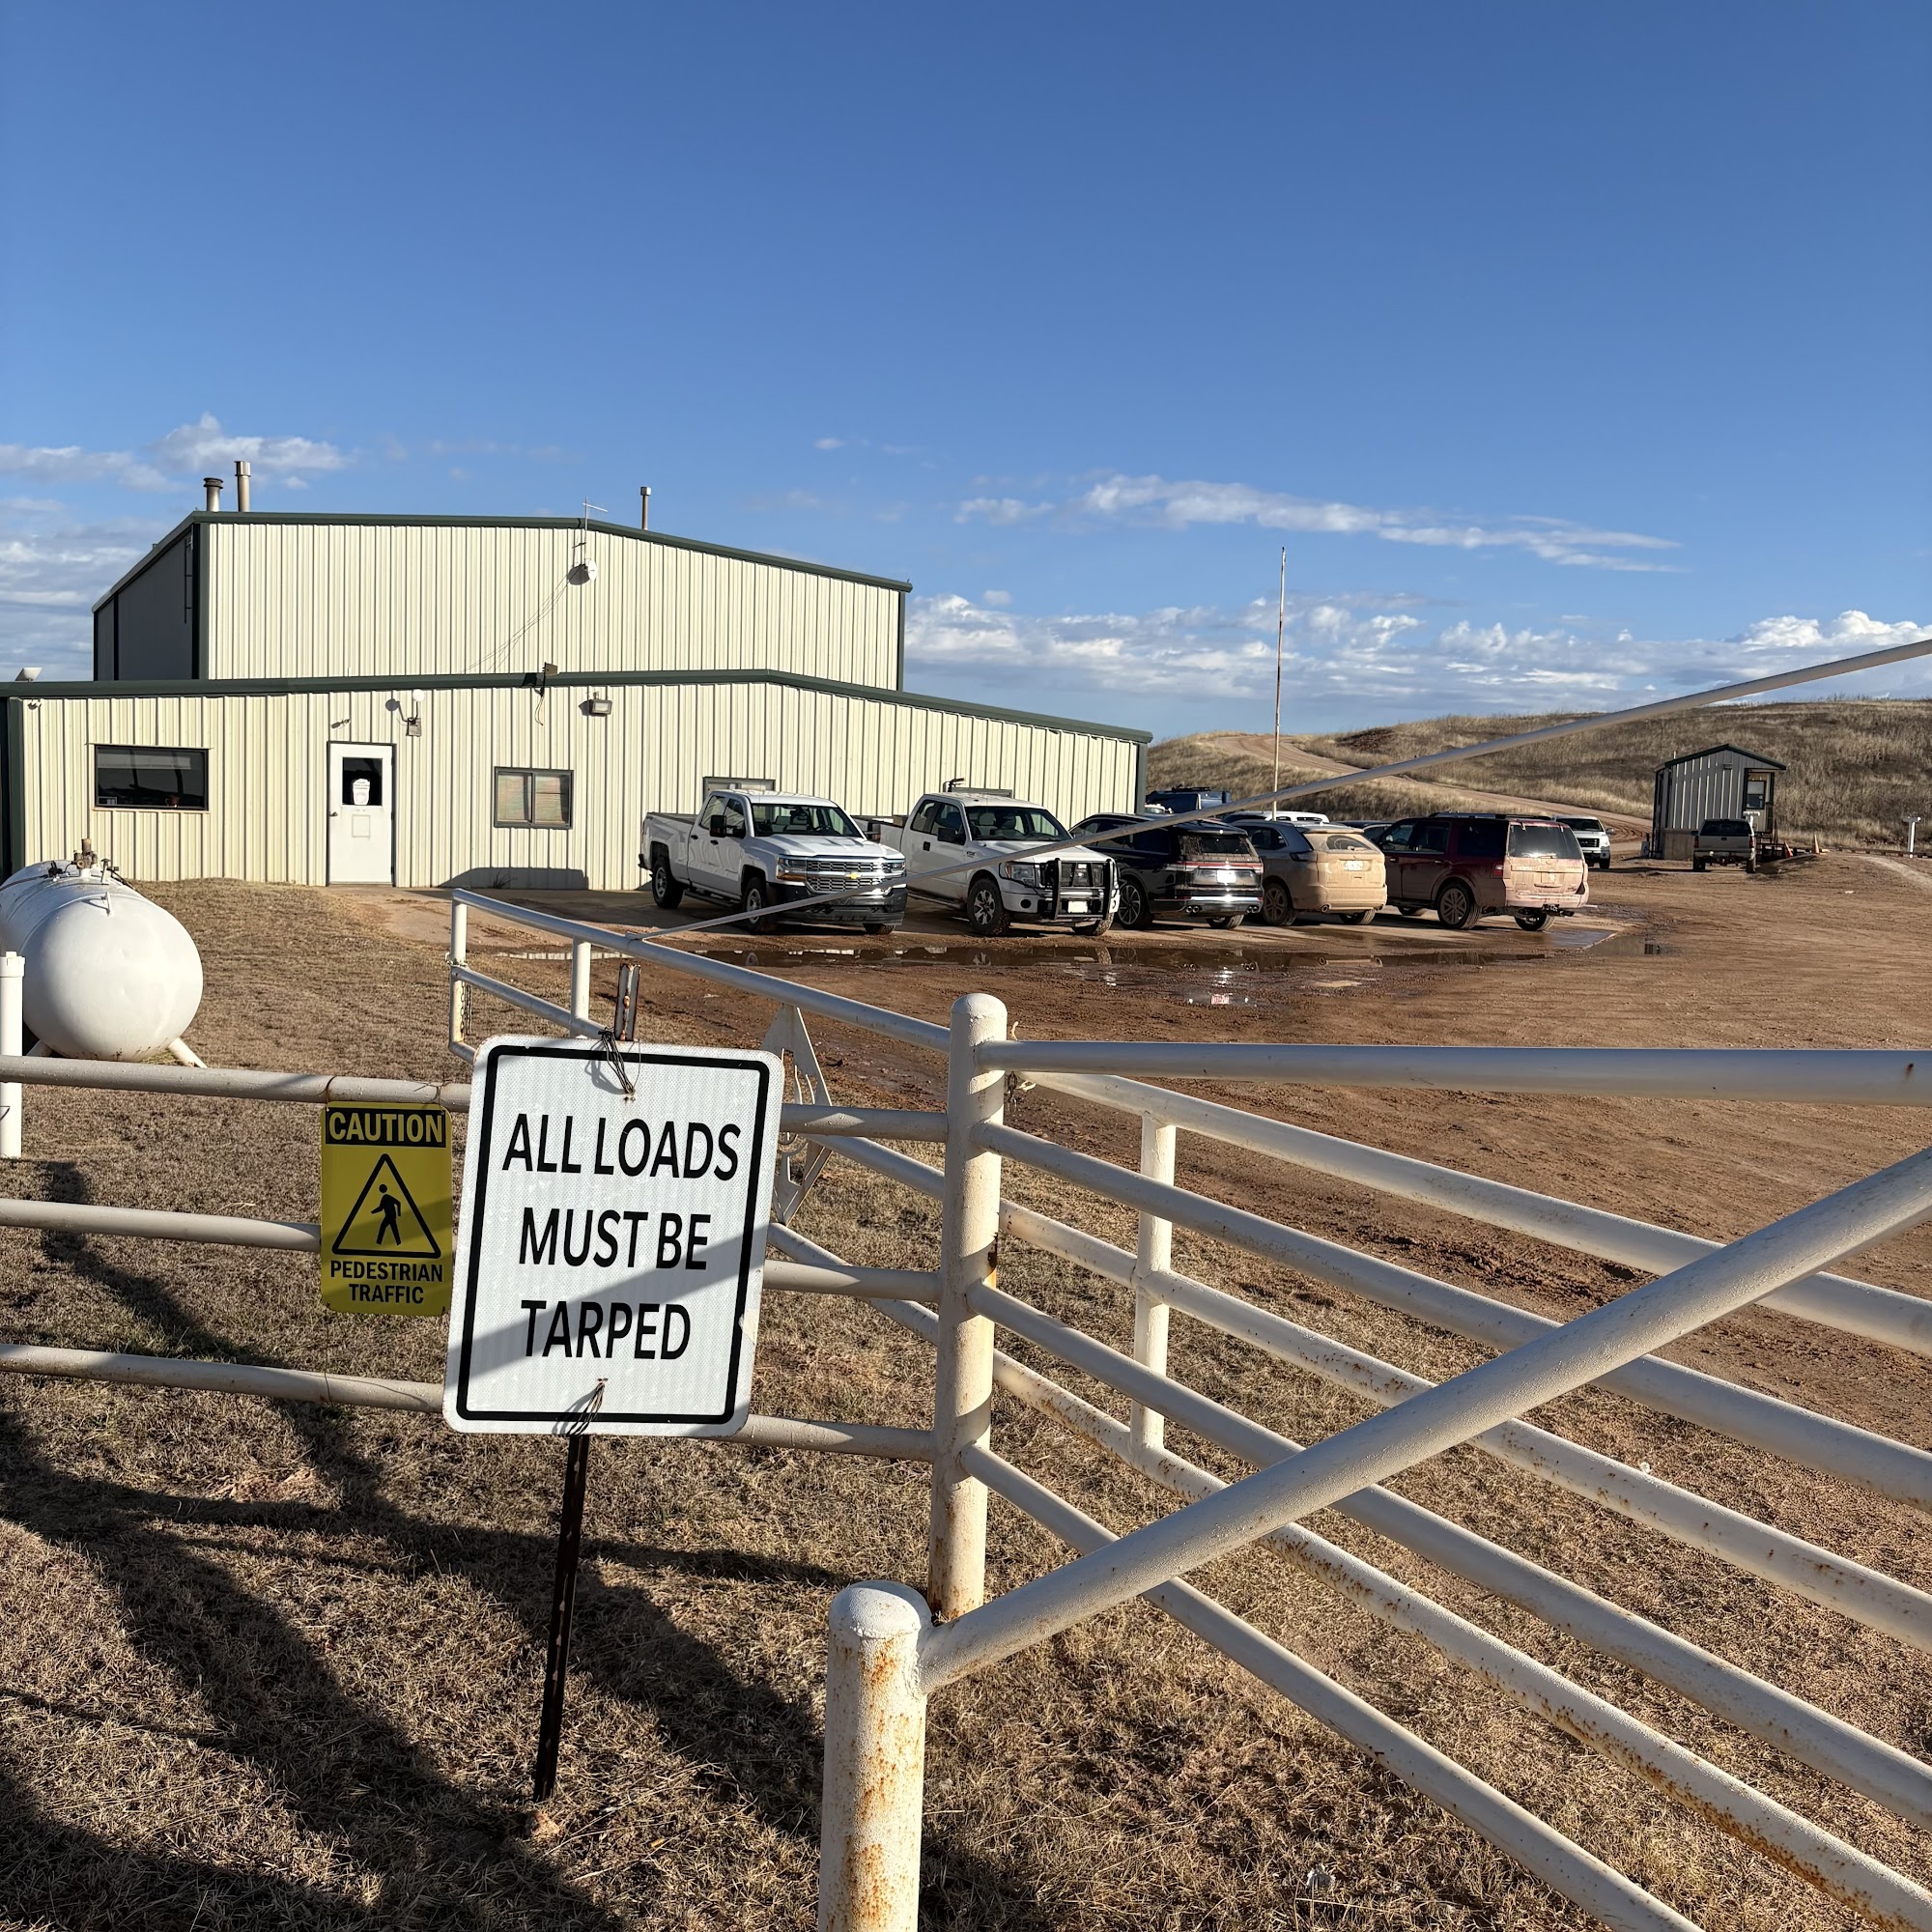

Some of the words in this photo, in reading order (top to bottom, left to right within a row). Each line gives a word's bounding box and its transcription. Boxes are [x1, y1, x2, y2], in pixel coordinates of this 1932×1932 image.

[328, 1112, 442, 1143] CAUTION
[502, 1114, 582, 1173] ALL
[594, 1117, 741, 1180] LOADS
[519, 1208, 649, 1267] MUST
[656, 1213, 712, 1270] BE
[330, 1260, 442, 1282] PEDESTRIAN
[349, 1283, 424, 1304] TRAFFIC
[521, 1299, 692, 1360] TARPED
